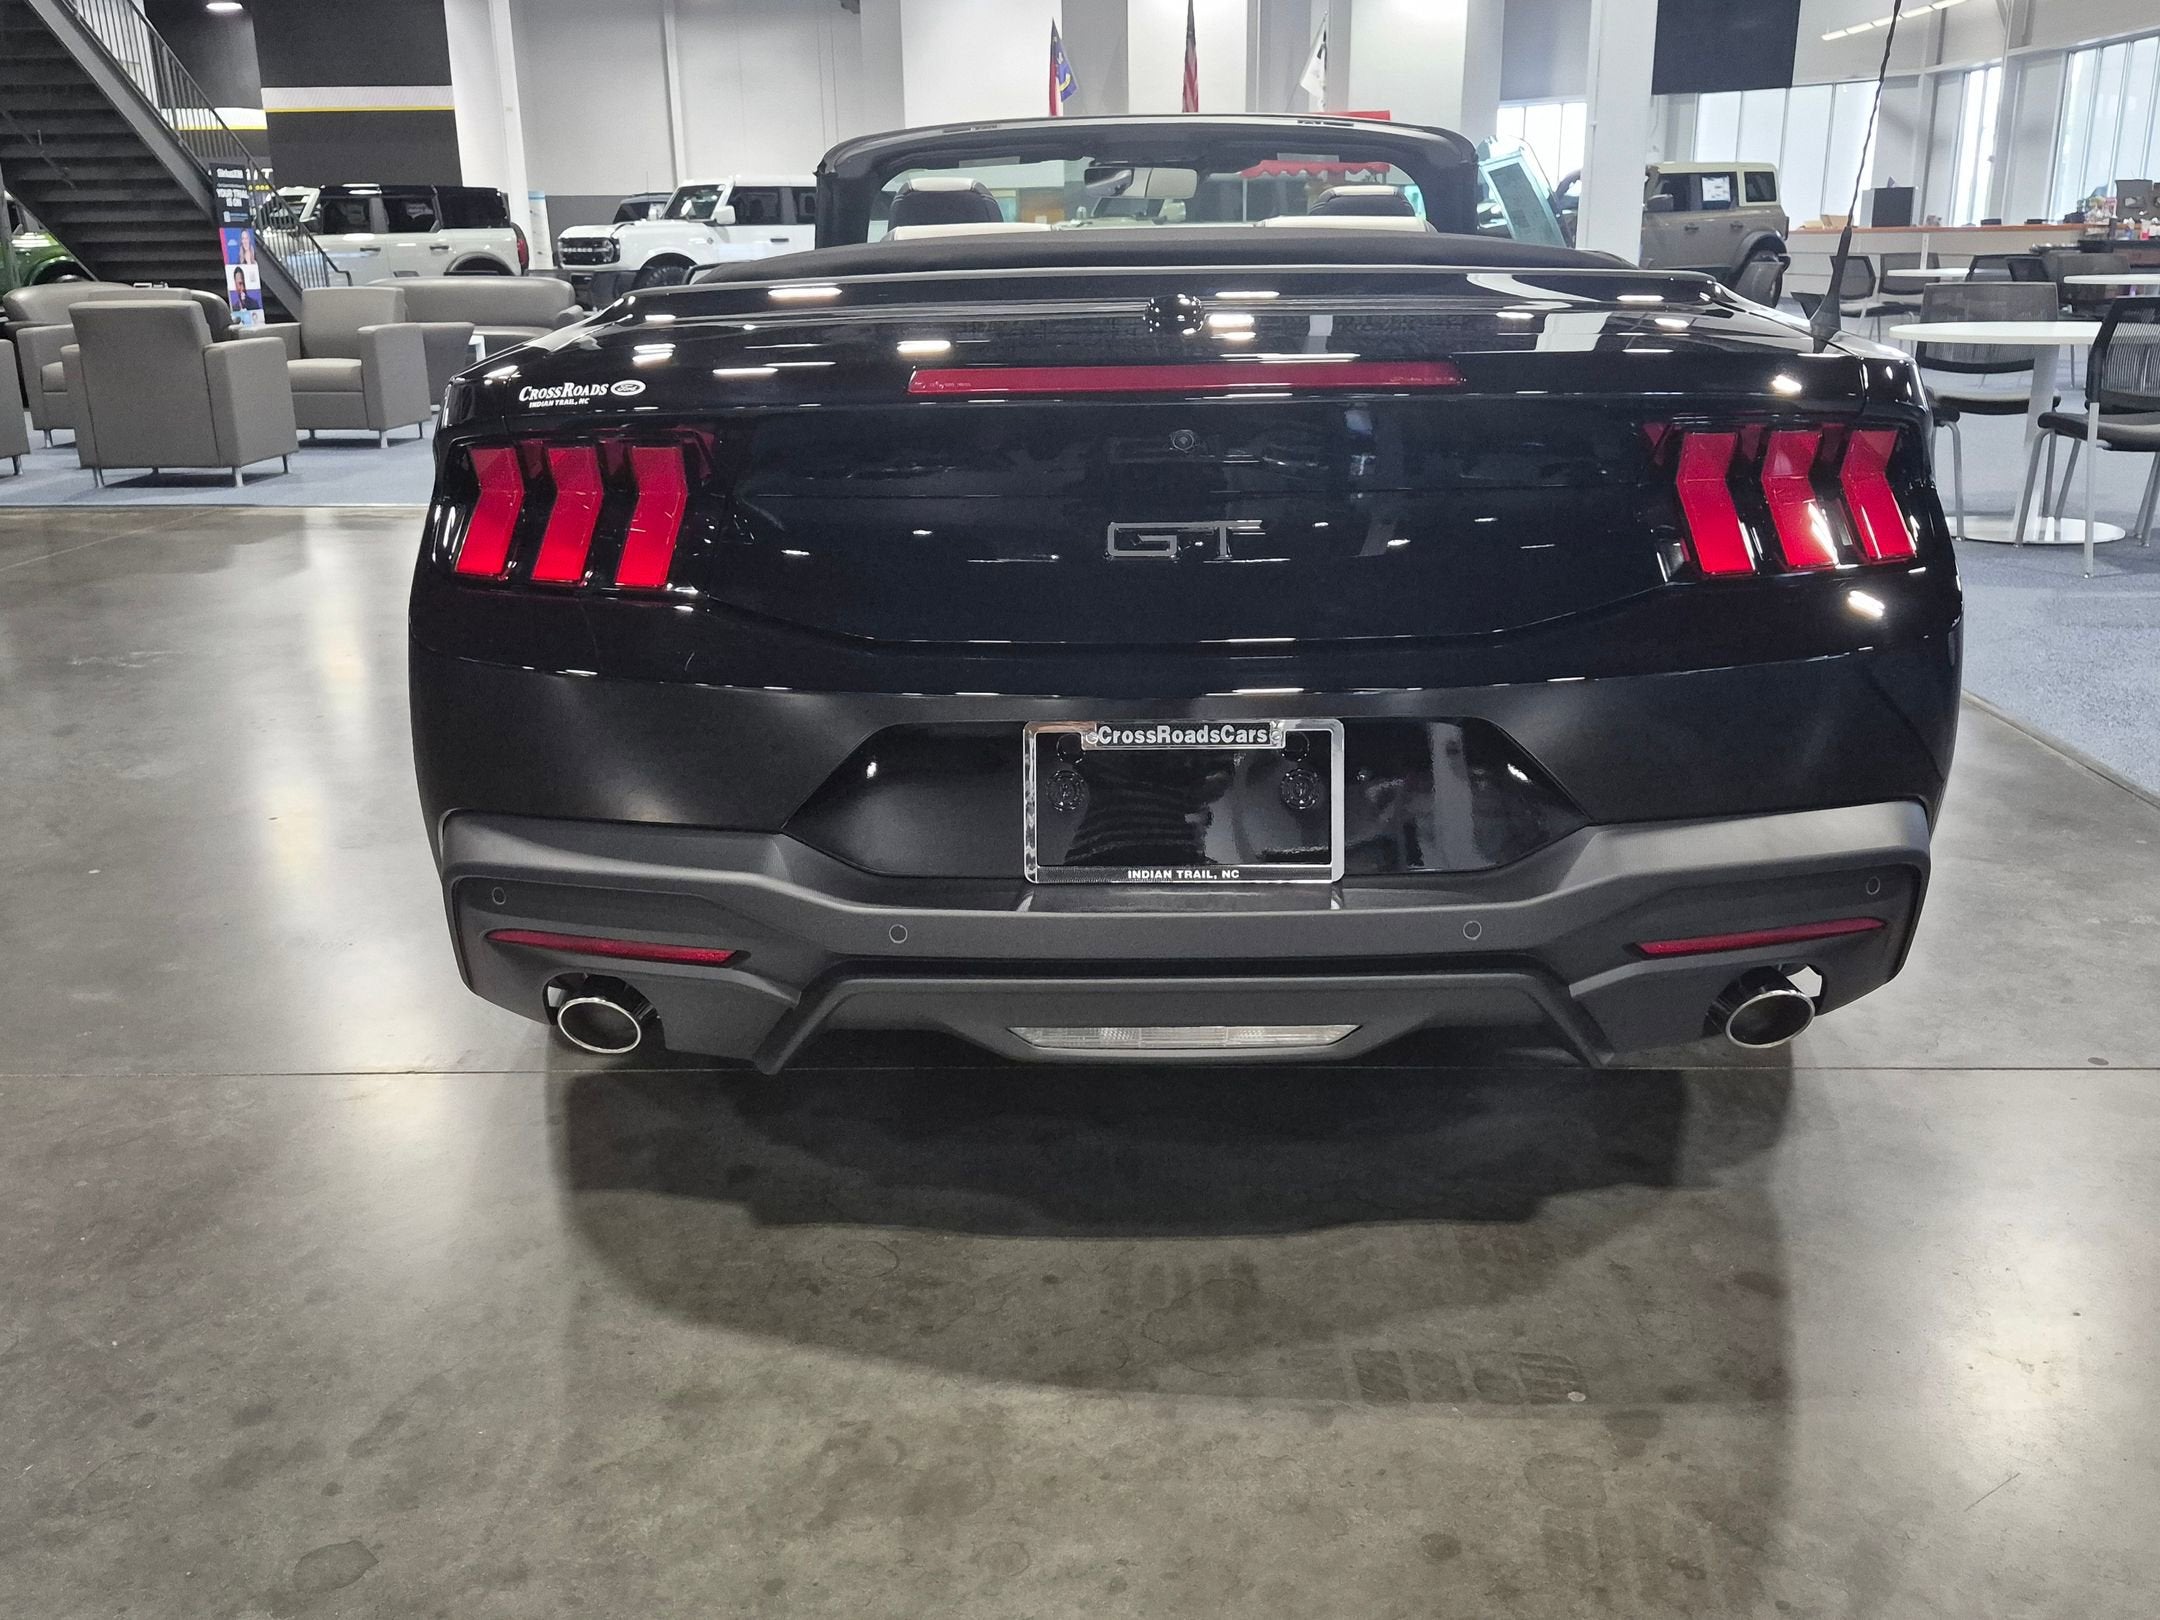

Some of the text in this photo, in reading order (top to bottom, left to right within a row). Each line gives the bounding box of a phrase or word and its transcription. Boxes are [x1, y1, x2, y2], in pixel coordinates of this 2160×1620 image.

[555, 399, 577, 407] TRAIL,
[1106, 520, 1264, 559] GT
[1098, 725, 1268, 744] CrossRoadsCars
[1127, 869, 1240, 880] INDIAN TRAIL, NC
